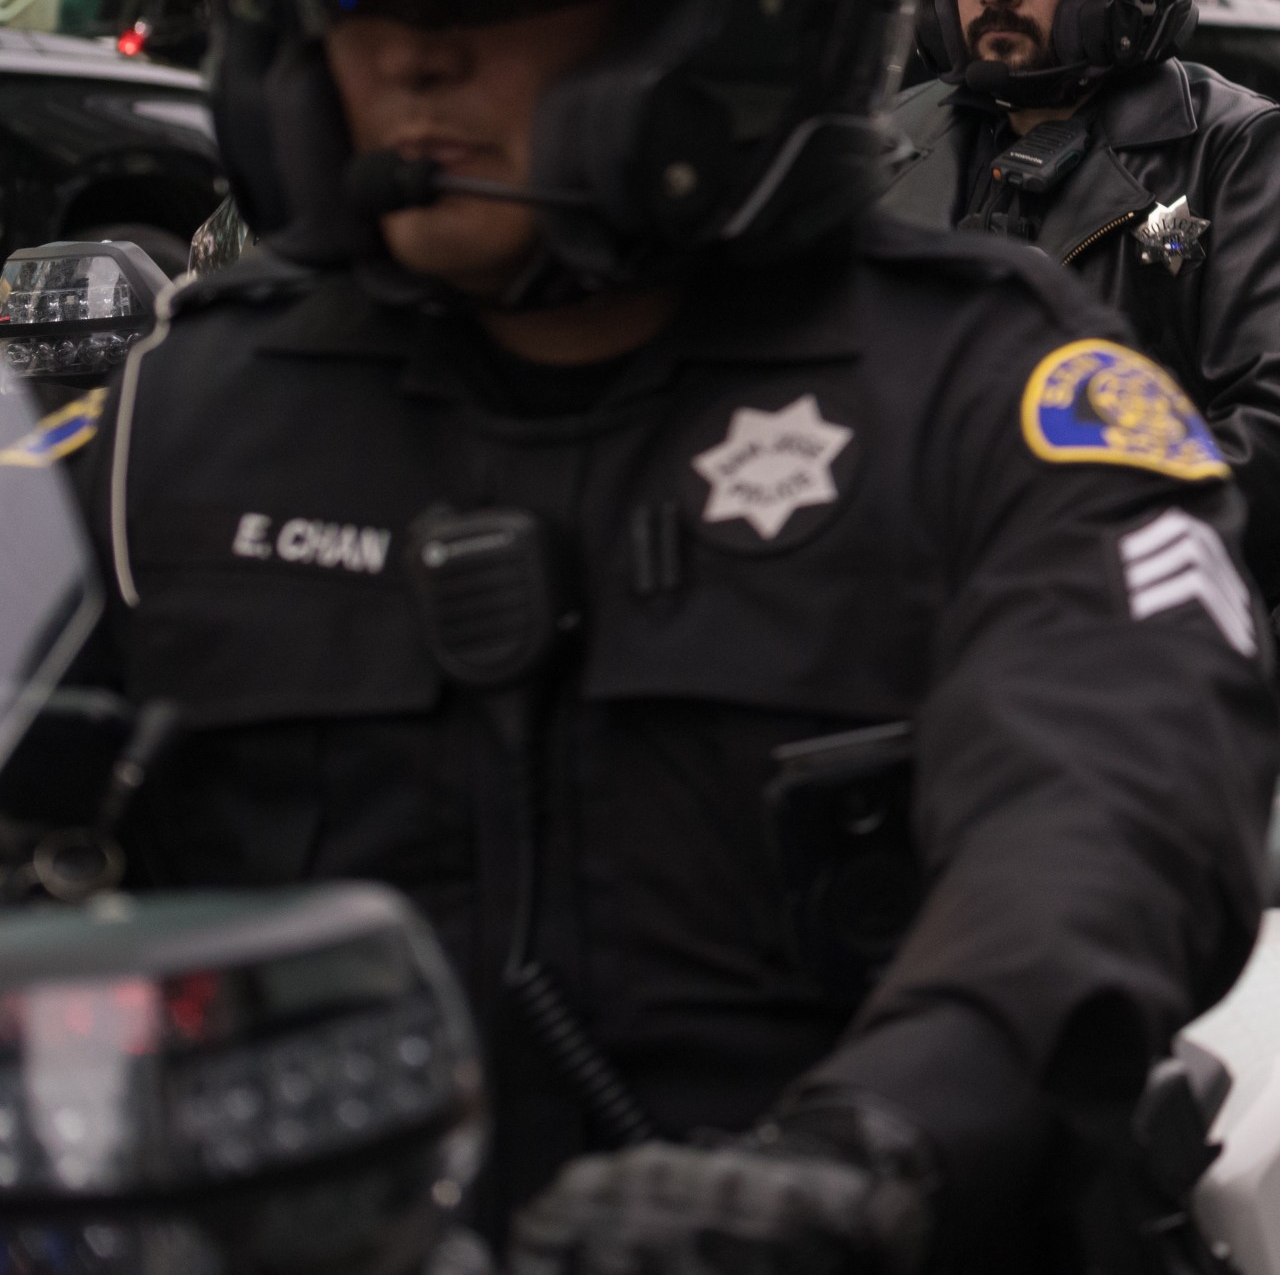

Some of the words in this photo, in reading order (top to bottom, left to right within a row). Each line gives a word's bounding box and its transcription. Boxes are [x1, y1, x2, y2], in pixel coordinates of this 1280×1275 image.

[1142, 218, 1197, 238] POLICE
[232, 512, 272, 560] E.
[276, 517, 391, 576] CHAN
